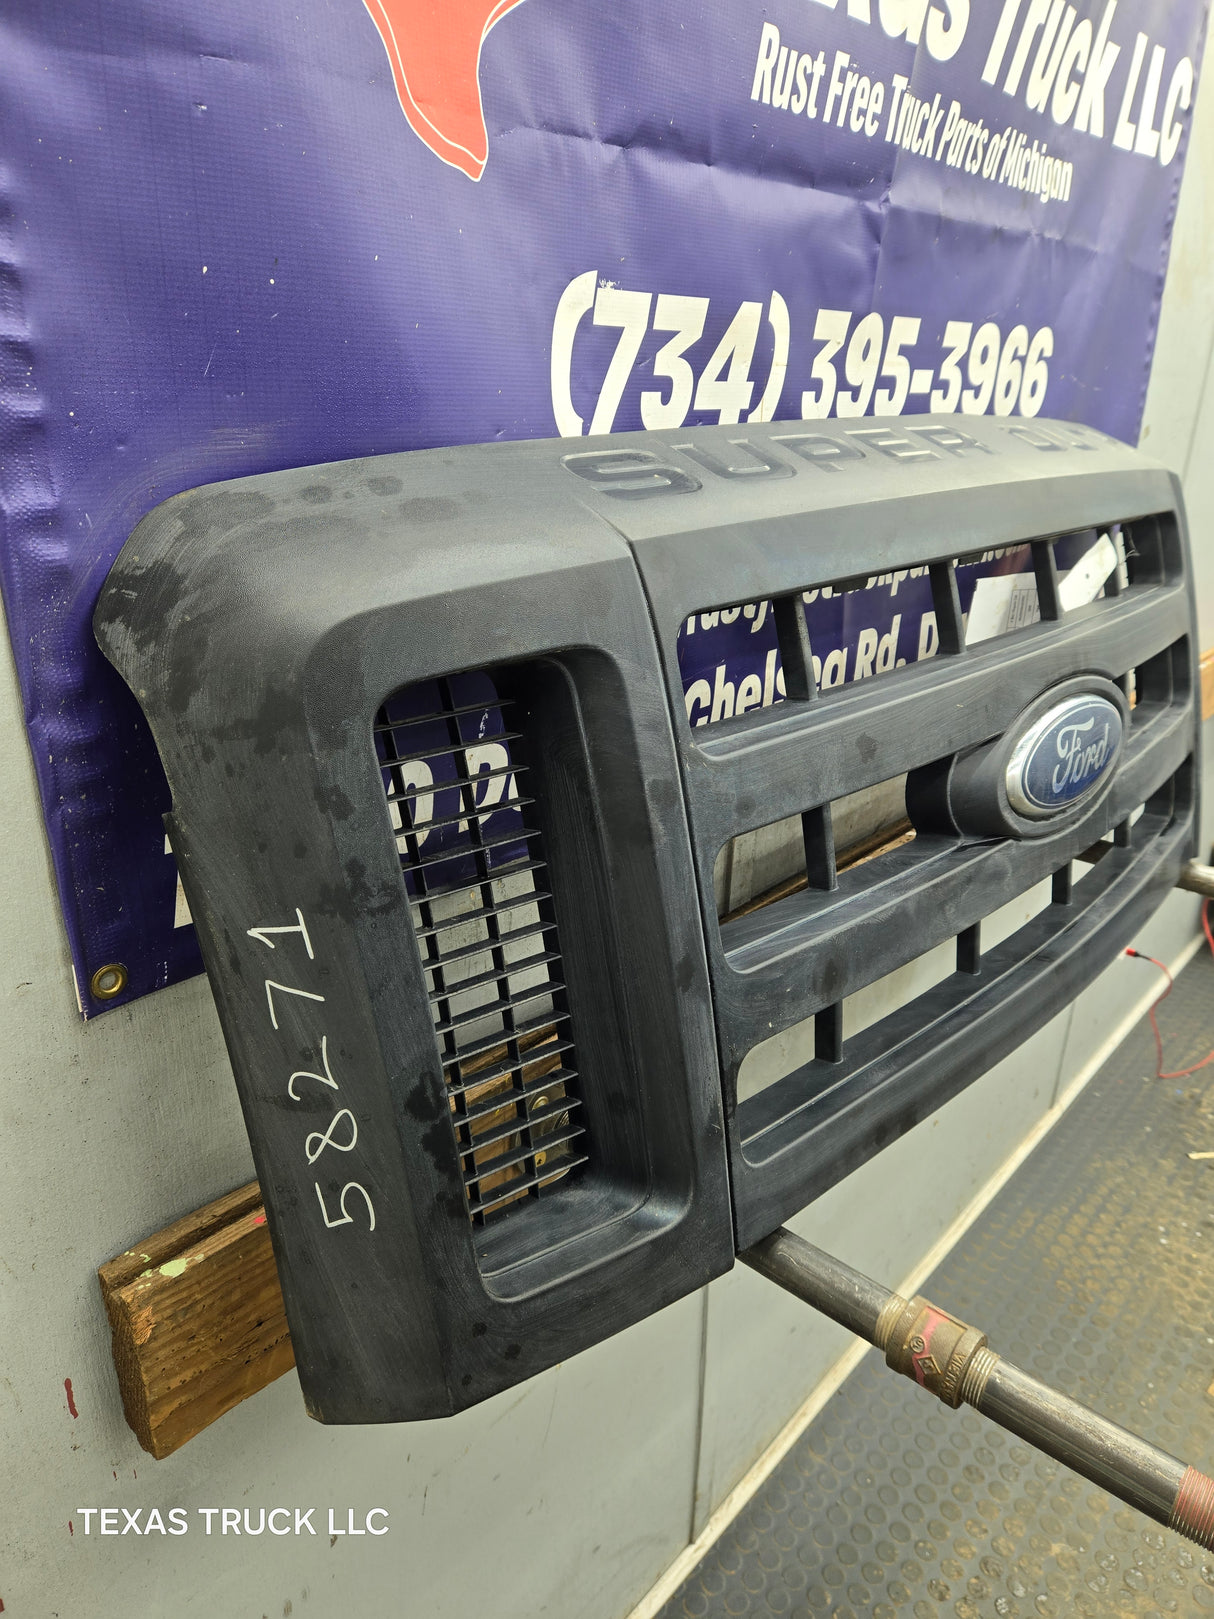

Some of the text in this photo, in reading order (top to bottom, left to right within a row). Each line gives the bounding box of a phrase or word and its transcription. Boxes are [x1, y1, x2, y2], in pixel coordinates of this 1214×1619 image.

[750, 21, 1074, 203] Rust Free Truck Parts of Michigan
[1112, 32, 1193, 166] LLC
[551, 270, 1055, 437] (734) 395-3966
[560, 425, 1000, 498] SUPER
[1052, 716, 1111, 794] Ford
[247, 907, 376, 1232] 58271
